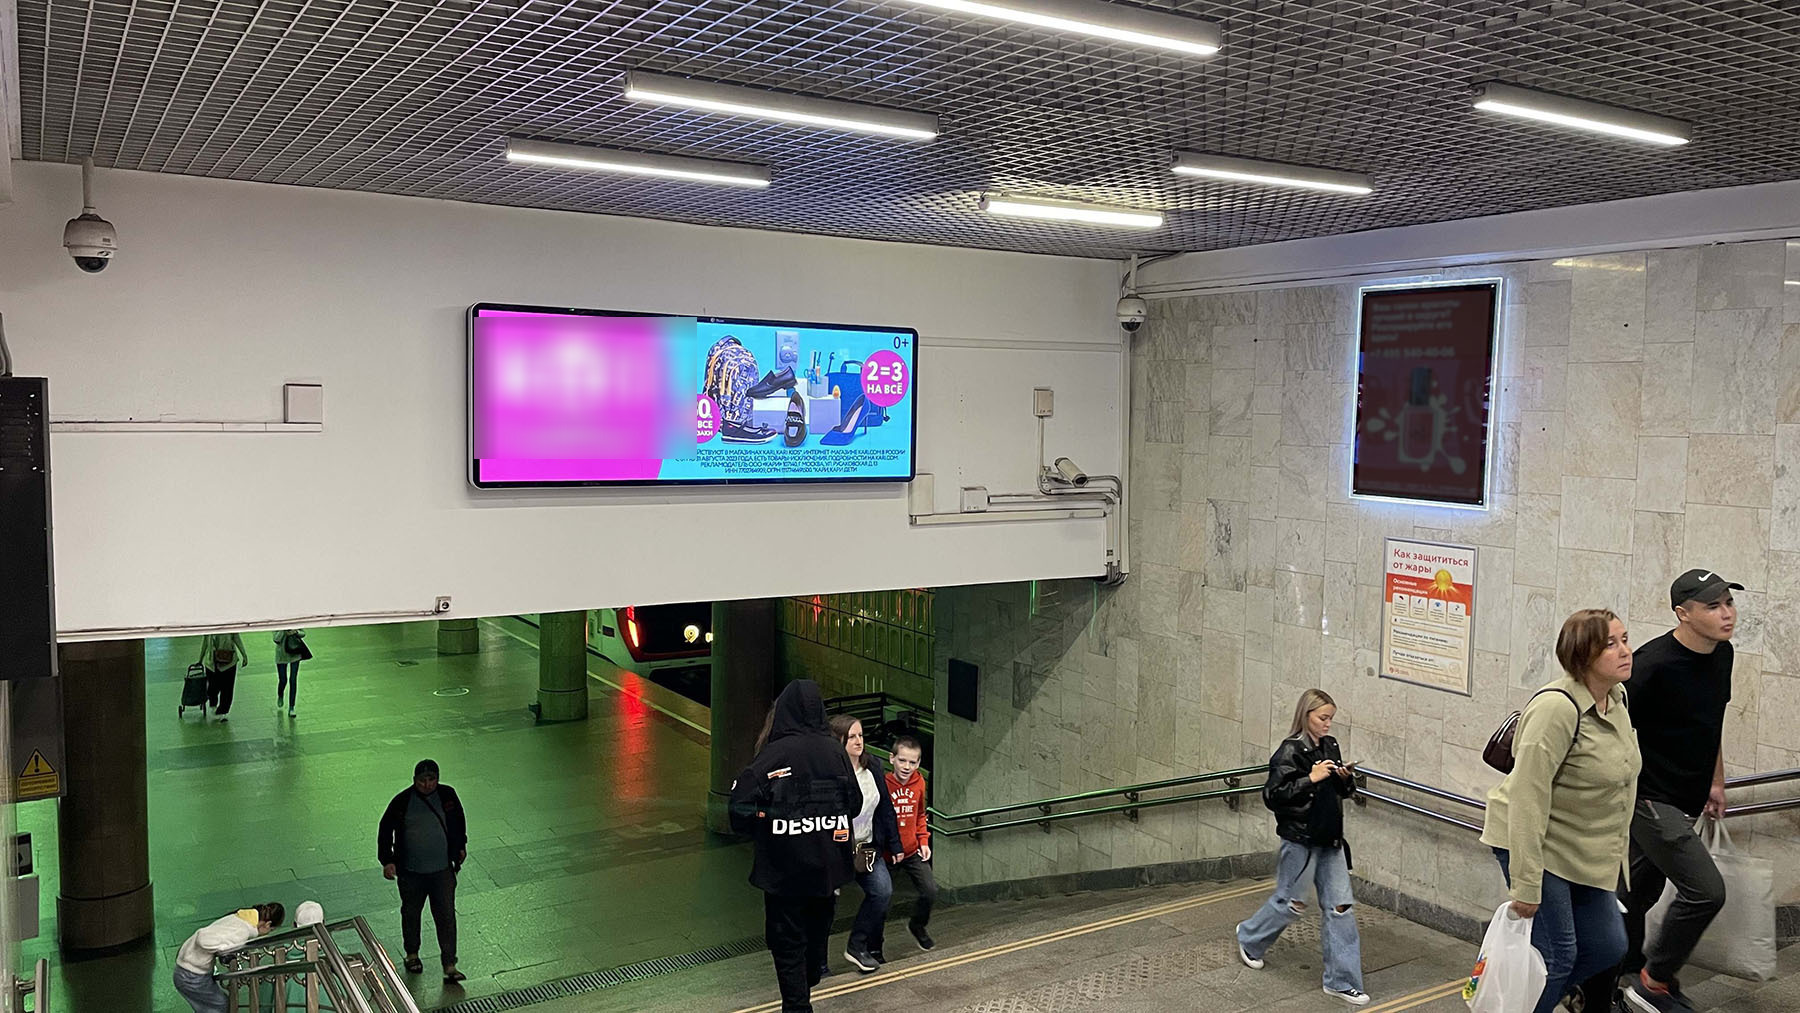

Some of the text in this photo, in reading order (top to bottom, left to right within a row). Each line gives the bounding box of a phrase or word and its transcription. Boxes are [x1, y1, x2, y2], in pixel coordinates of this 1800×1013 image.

[893, 336, 909, 349] 0+
[867, 383, 882, 394] НА
[1394, 548, 1469, 567] Как защититься
[1393, 561, 1432, 574] от жары
[772, 814, 849, 835] DESIGN
